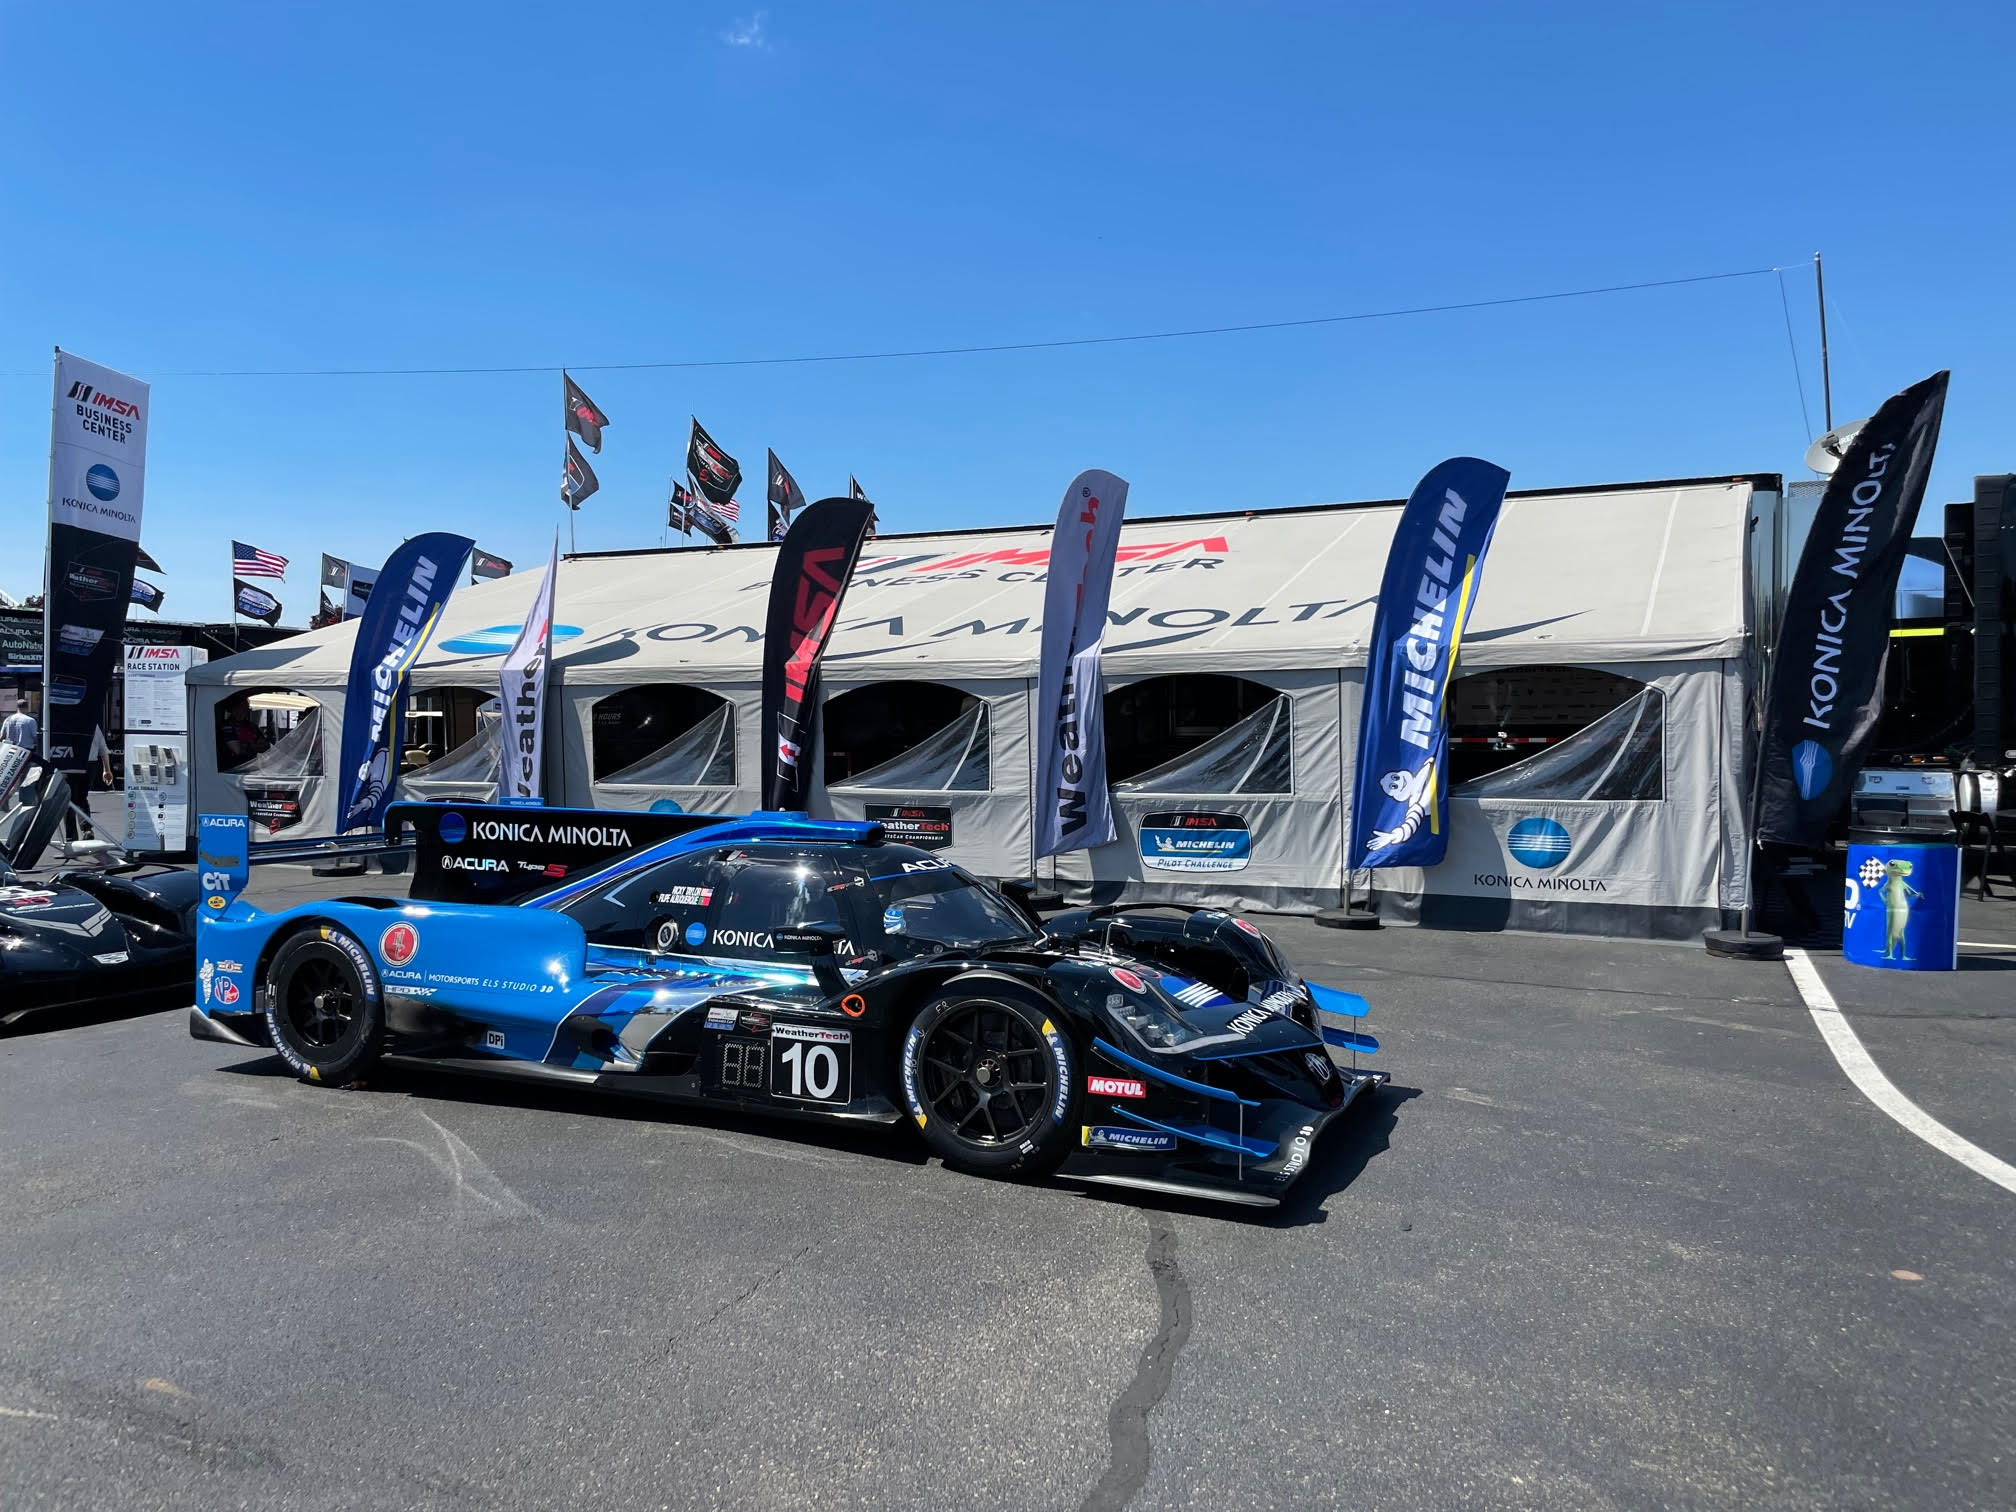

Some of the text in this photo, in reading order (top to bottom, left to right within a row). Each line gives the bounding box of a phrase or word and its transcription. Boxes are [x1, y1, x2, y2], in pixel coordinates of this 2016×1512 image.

[92, 391, 140, 421] IMSA
[76, 404, 132, 434] BUSINESS
[82, 419, 127, 444] CENTER
[62, 497, 98, 513] KONICA
[100, 505, 136, 523] MINOLTA
[1401, 488, 1468, 750] MICHELIN
[144, 648, 180, 658] IMSA
[371, 555, 438, 743] MICHELIN
[1803, 589, 1853, 729] KONICA
[209, 818, 246, 827] ACURA
[1185, 817, 1217, 826] IMSA
[473, 821, 632, 847] KONICA MINOLTA
[1175, 840, 1235, 849] MICHELIN
[453, 857, 509, 872] ACURA
[1474, 874, 1607, 891] KONICA MINOLTA
[712, 929, 775, 949] KONICA
[338, 935, 375, 996] MICHELIN
[389, 970, 479, 986] ACURA MOTORSPORTS
[482, 978, 554, 994] ELS STUDIO 3D
[1226, 1007, 1272, 1036] KONICA
[488, 1032, 505, 1048] DPi
[775, 1026, 849, 1041] WeatherTech
[781, 1042, 839, 1099] 10
[903, 1034, 917, 1103] MICHELIN
[1054, 1047, 1070, 1119] MICHELIN
[1090, 1079, 1143, 1096] MOTUL
[1108, 1133, 1168, 1145] MICHELIN
